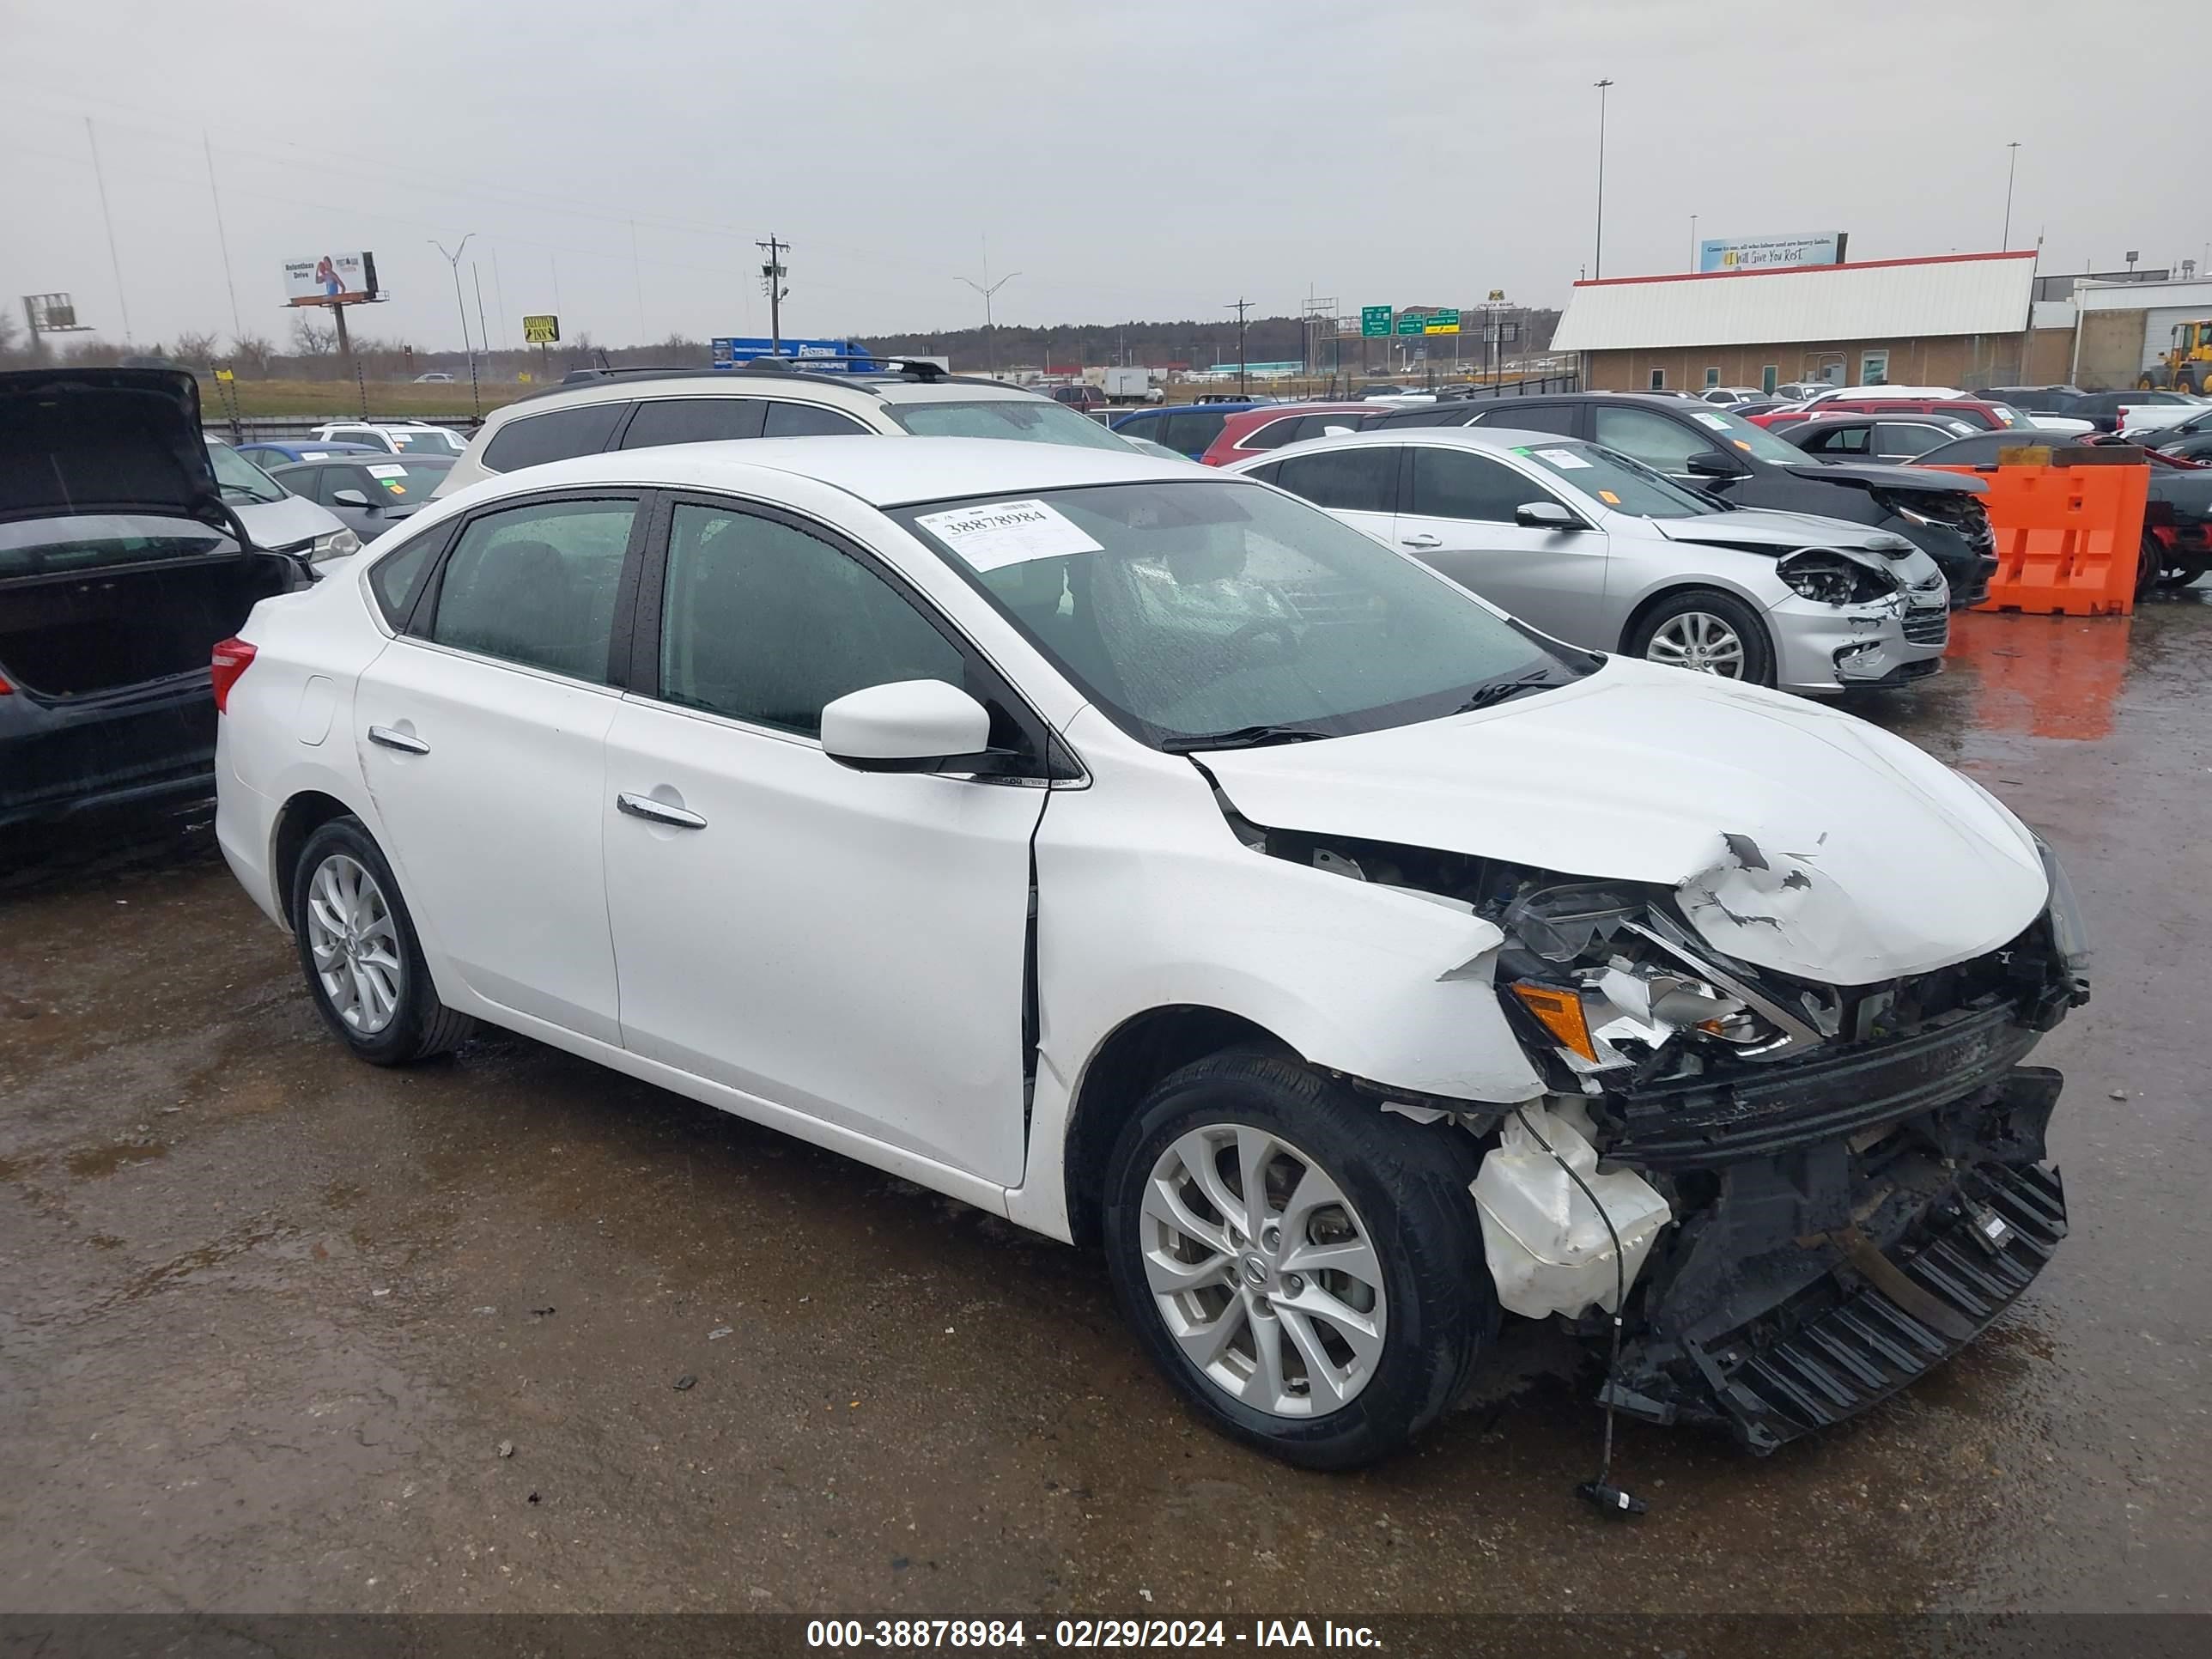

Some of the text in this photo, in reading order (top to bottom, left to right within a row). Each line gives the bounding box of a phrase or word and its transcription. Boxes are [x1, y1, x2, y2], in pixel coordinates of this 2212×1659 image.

[1751, 251, 1767, 264] Give
[1770, 249, 1783, 262] You
[285, 262, 314, 270] Relentless
[945, 510, 1048, 535] 38878984
